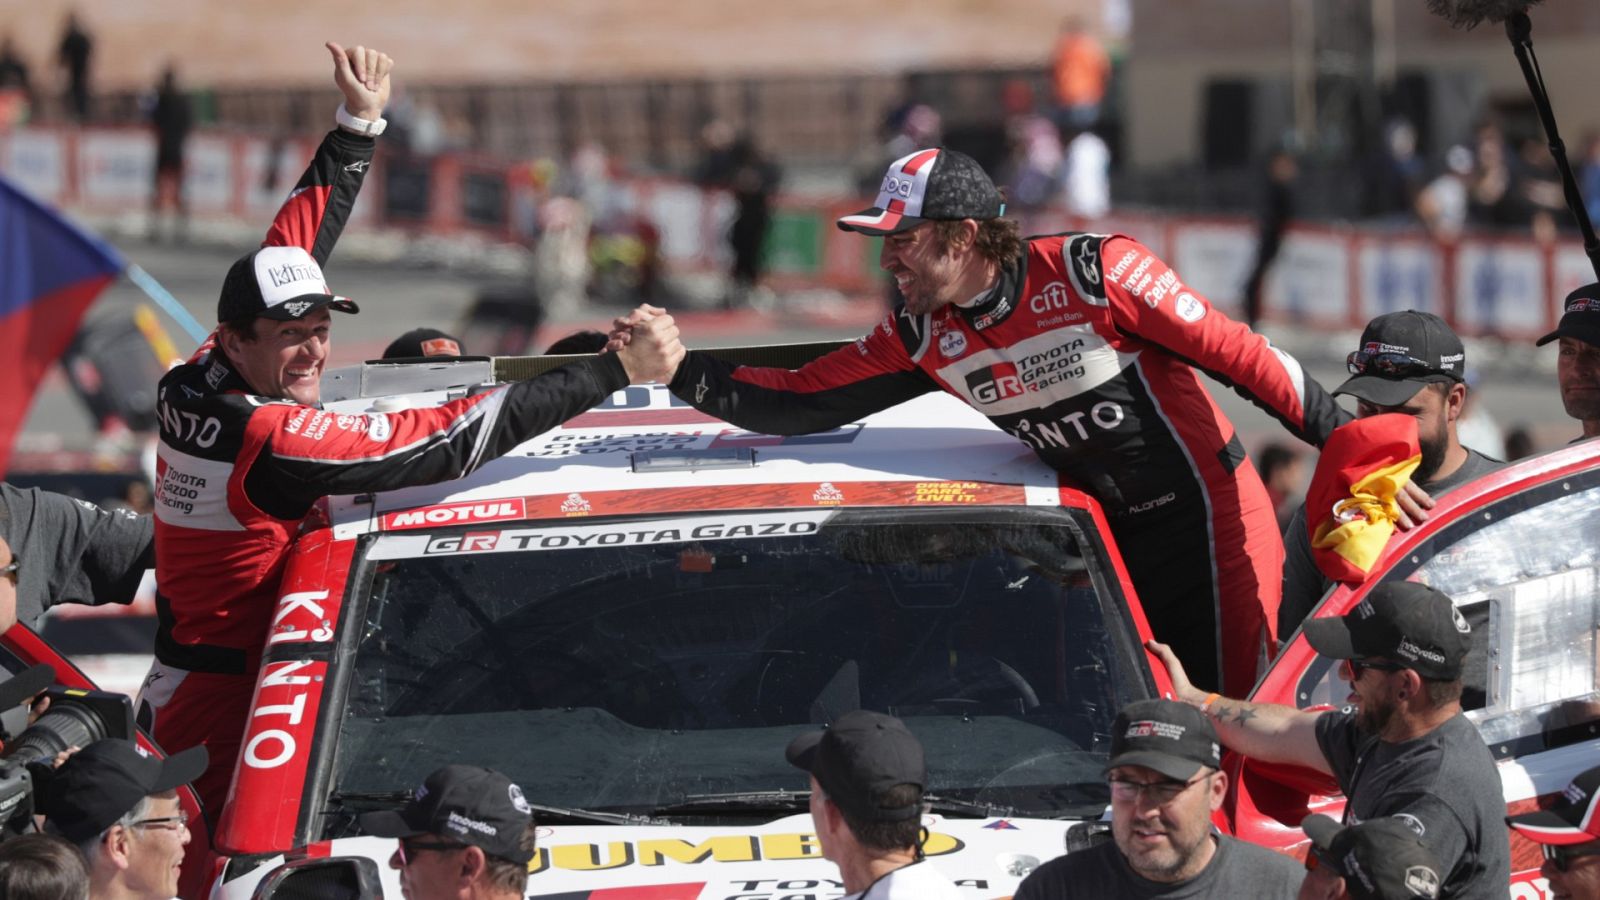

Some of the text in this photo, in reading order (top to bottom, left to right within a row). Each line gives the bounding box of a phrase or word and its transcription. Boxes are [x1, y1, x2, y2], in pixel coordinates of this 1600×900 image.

[1030, 281, 1069, 314] citi
[1037, 311, 1084, 329] Private Bank
[1018, 338, 1085, 371] TOYOTA
[1021, 352, 1083, 384] GAZOO
[1025, 364, 1086, 393] Racing
[971, 373, 1024, 404] GR
[163, 479, 199, 500] GAZOO
[168, 465, 207, 489] TOYOTA
[915, 482, 982, 490] DREAM.
[916, 488, 967, 496] DARE.
[916, 494, 977, 502] LIVE IT.
[391, 502, 518, 527] MOTUL
[425, 521, 818, 555] GR TOYOTA GAZO
